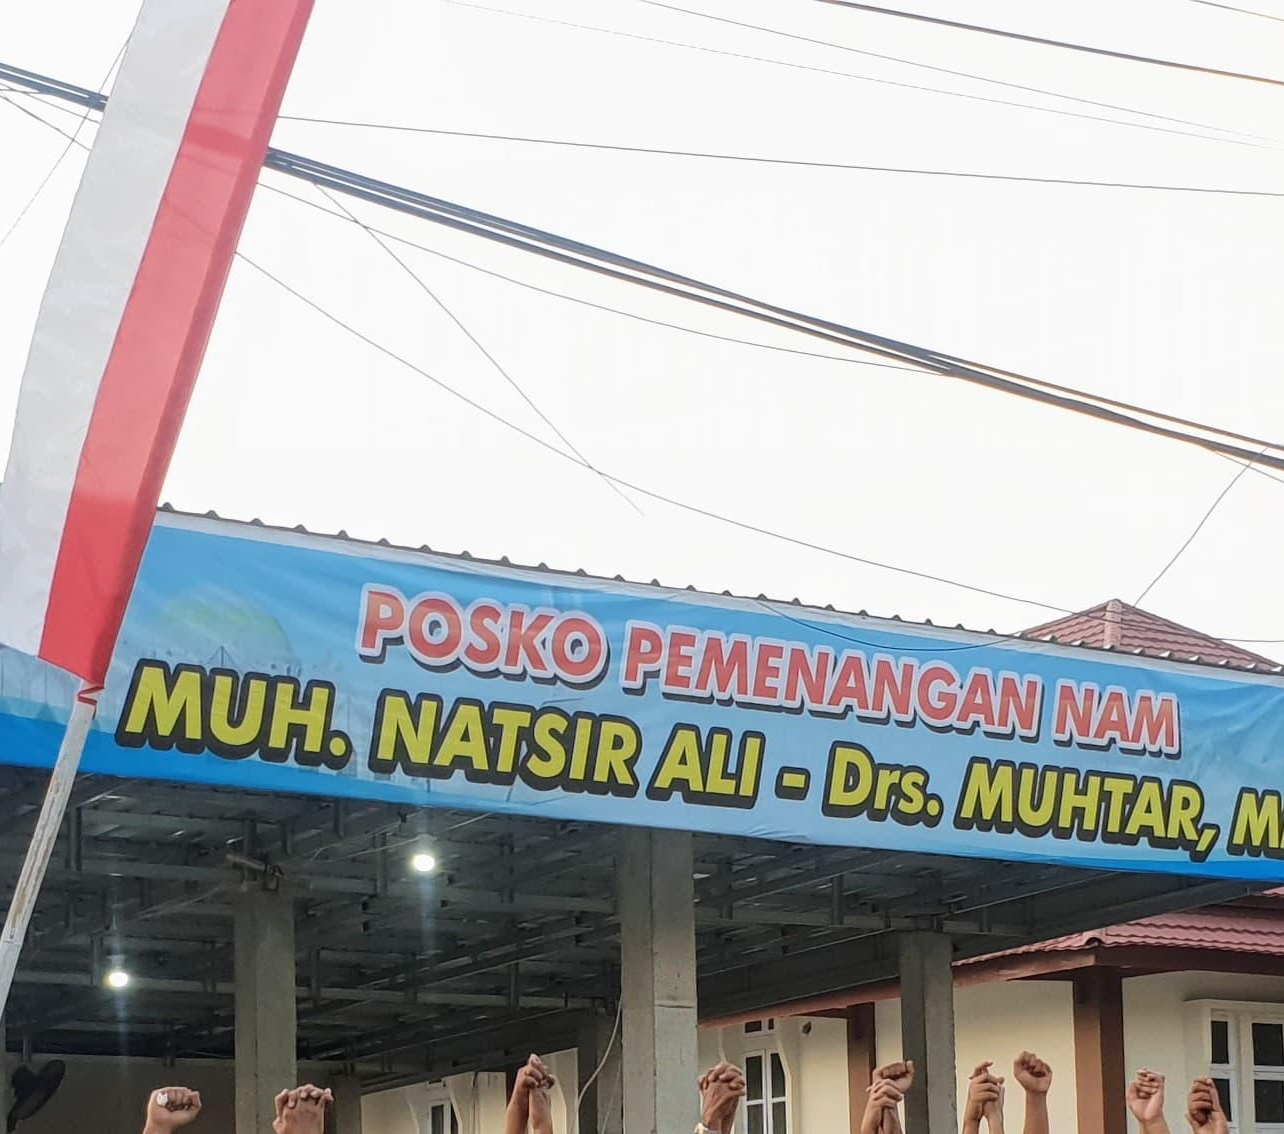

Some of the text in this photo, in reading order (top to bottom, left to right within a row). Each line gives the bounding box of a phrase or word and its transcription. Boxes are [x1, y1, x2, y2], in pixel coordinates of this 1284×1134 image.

[121, 660, 351, 766] MUH.
[375, 690, 642, 795] NATSIR
[648, 729, 765, 801] ALI
[823, 742, 944, 828] Drs.
[959, 757, 1217, 860] MUHTAR,
[358, 584, 1182, 755] POSKO PEMENANGAN NAM
